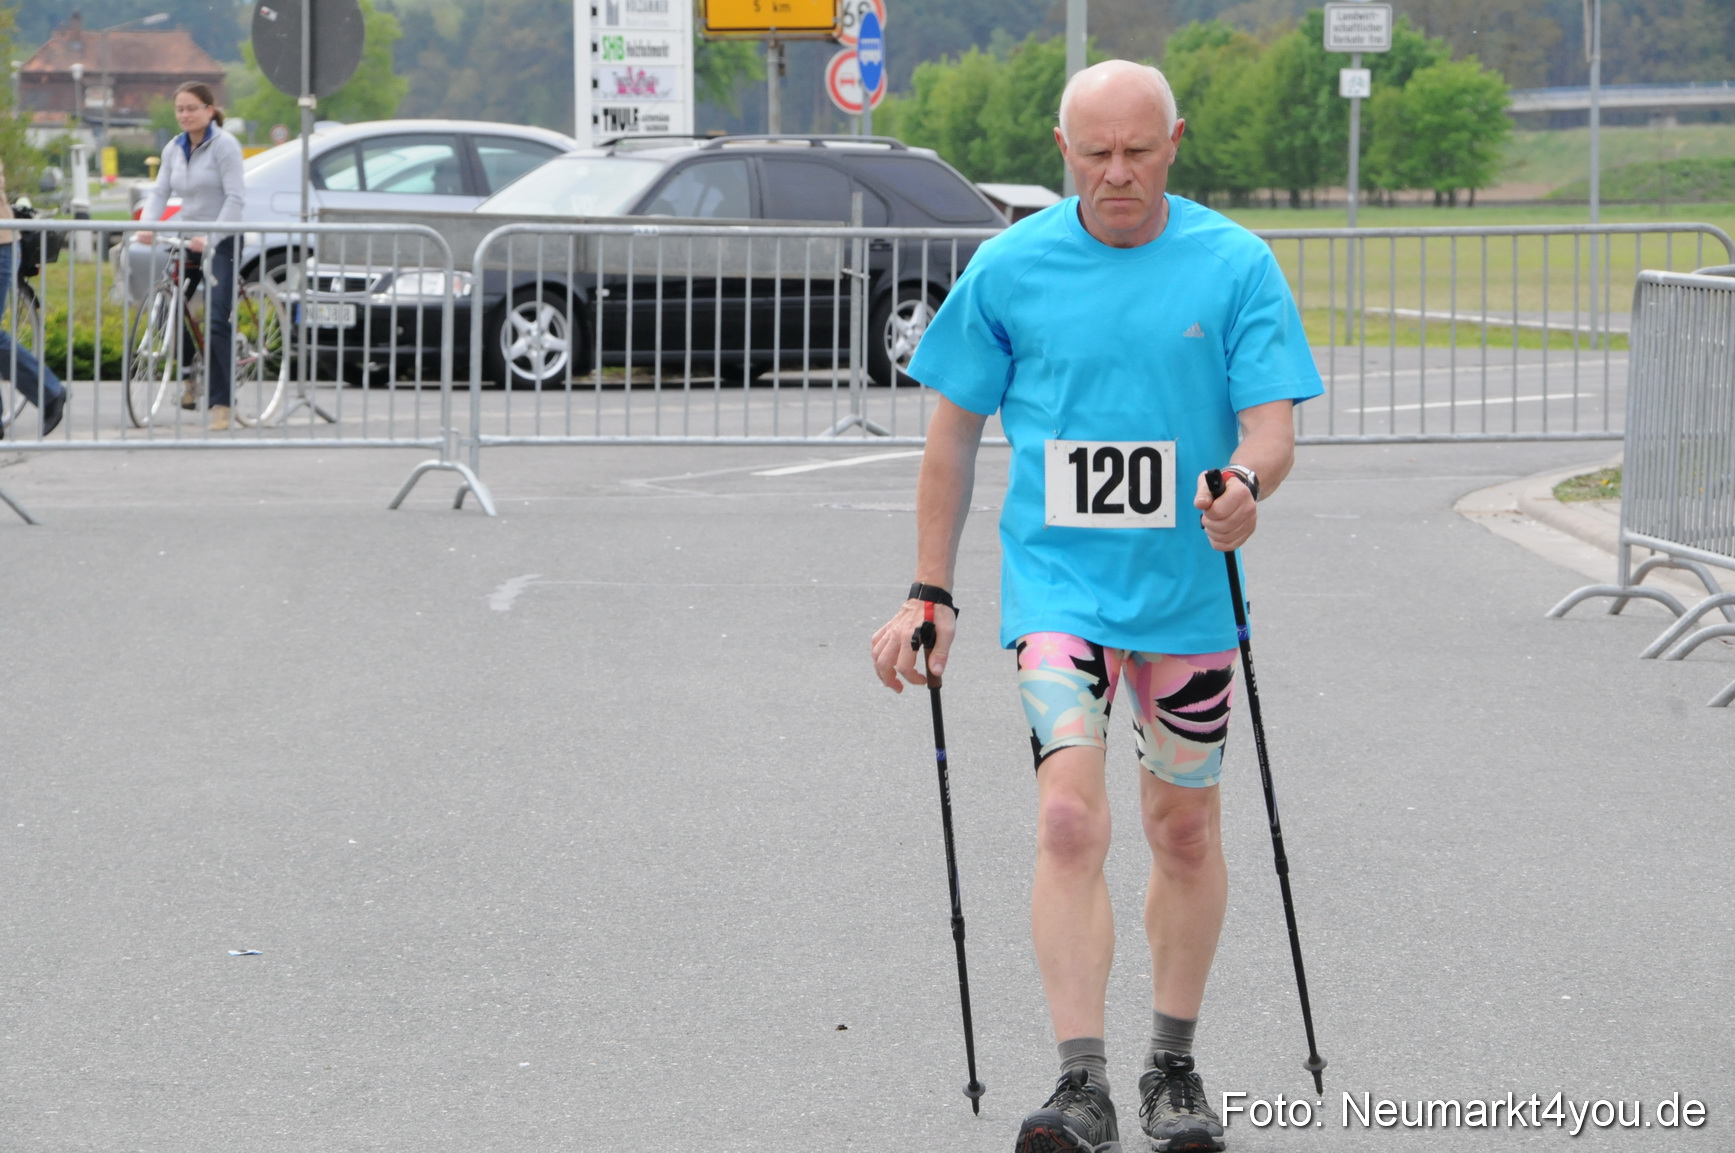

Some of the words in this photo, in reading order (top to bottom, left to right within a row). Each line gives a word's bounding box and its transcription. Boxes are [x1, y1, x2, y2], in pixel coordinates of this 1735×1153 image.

[753, 0, 761, 13] 5
[772, 0, 792, 13] km
[1333, 23, 1383, 32] schaftlicher
[602, 35, 624, 60] SHB
[1333, 34, 1365, 43] Verkehr
[603, 107, 639, 132] THULE
[1069, 446, 1162, 514] 120
